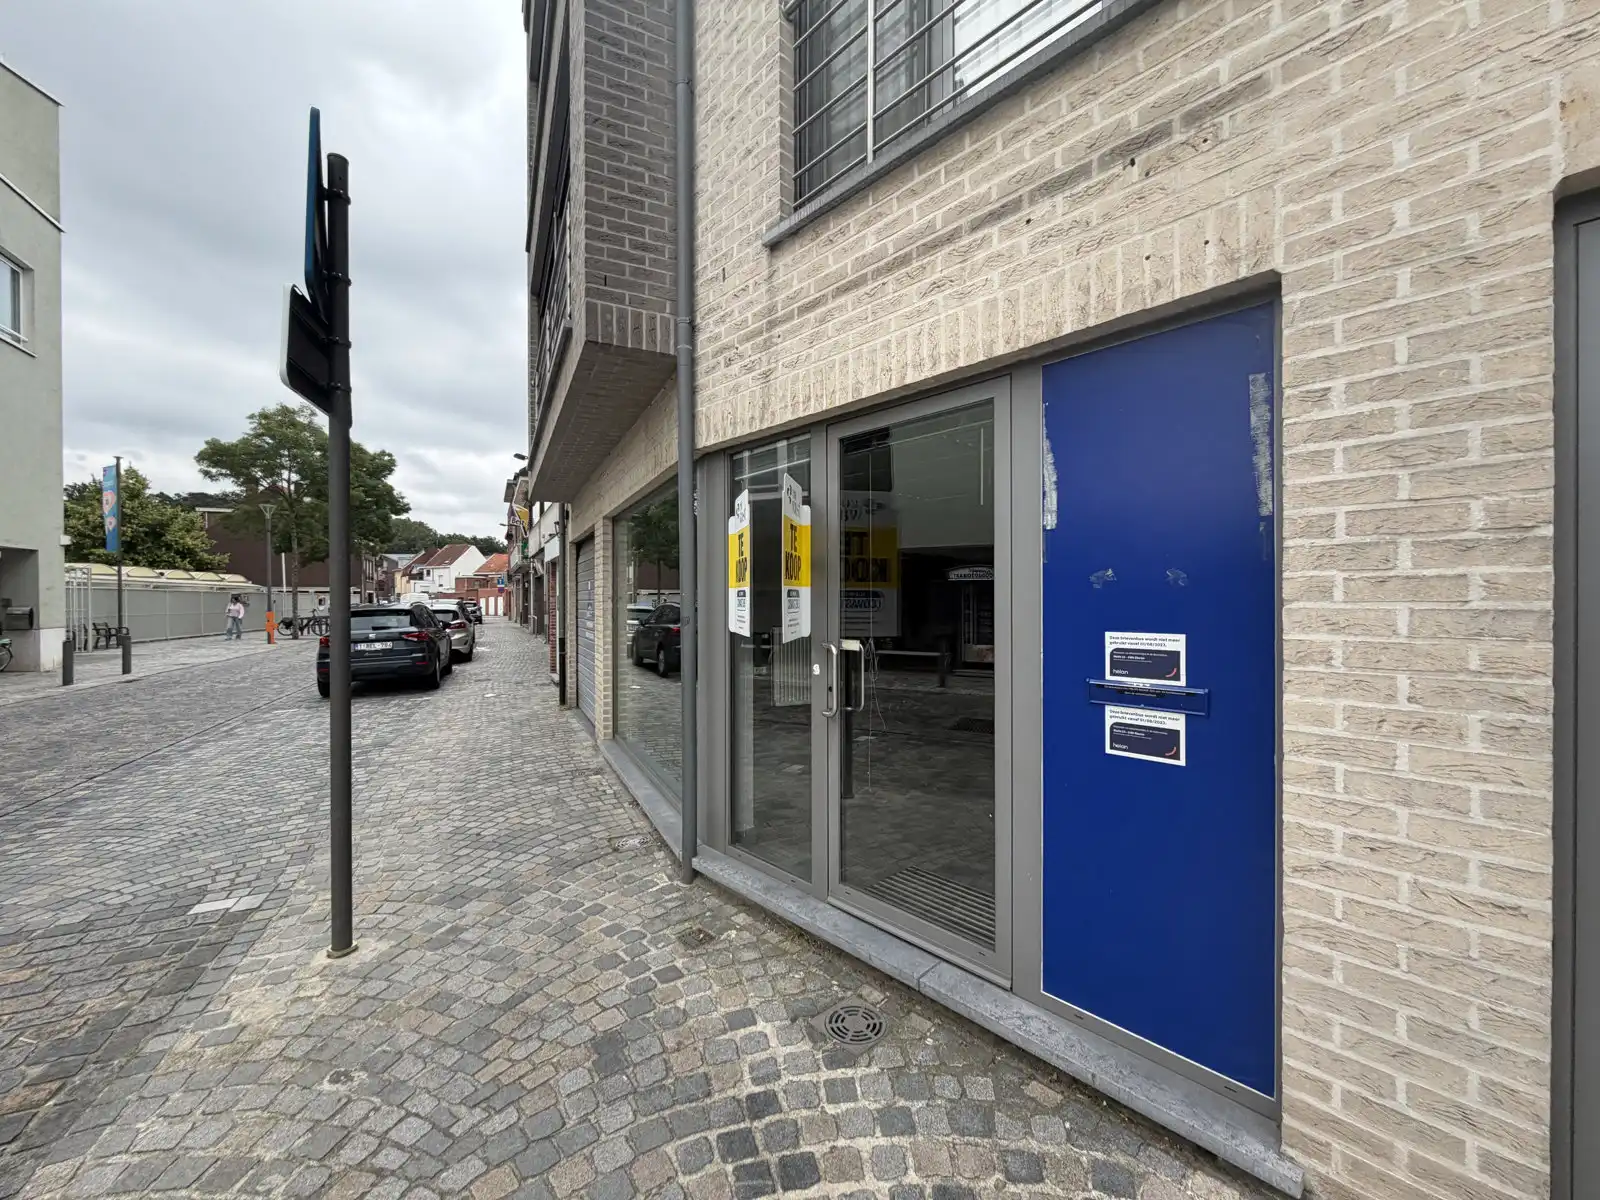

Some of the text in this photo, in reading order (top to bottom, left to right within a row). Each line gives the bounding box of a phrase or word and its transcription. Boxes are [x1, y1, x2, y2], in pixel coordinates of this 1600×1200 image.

[738, 532, 745, 557] TE
[789, 523, 798, 552] TE
[735, 556, 748, 583] KOOP
[785, 552, 802, 582] KOOP
[1112, 742, 1129, 750] helan
